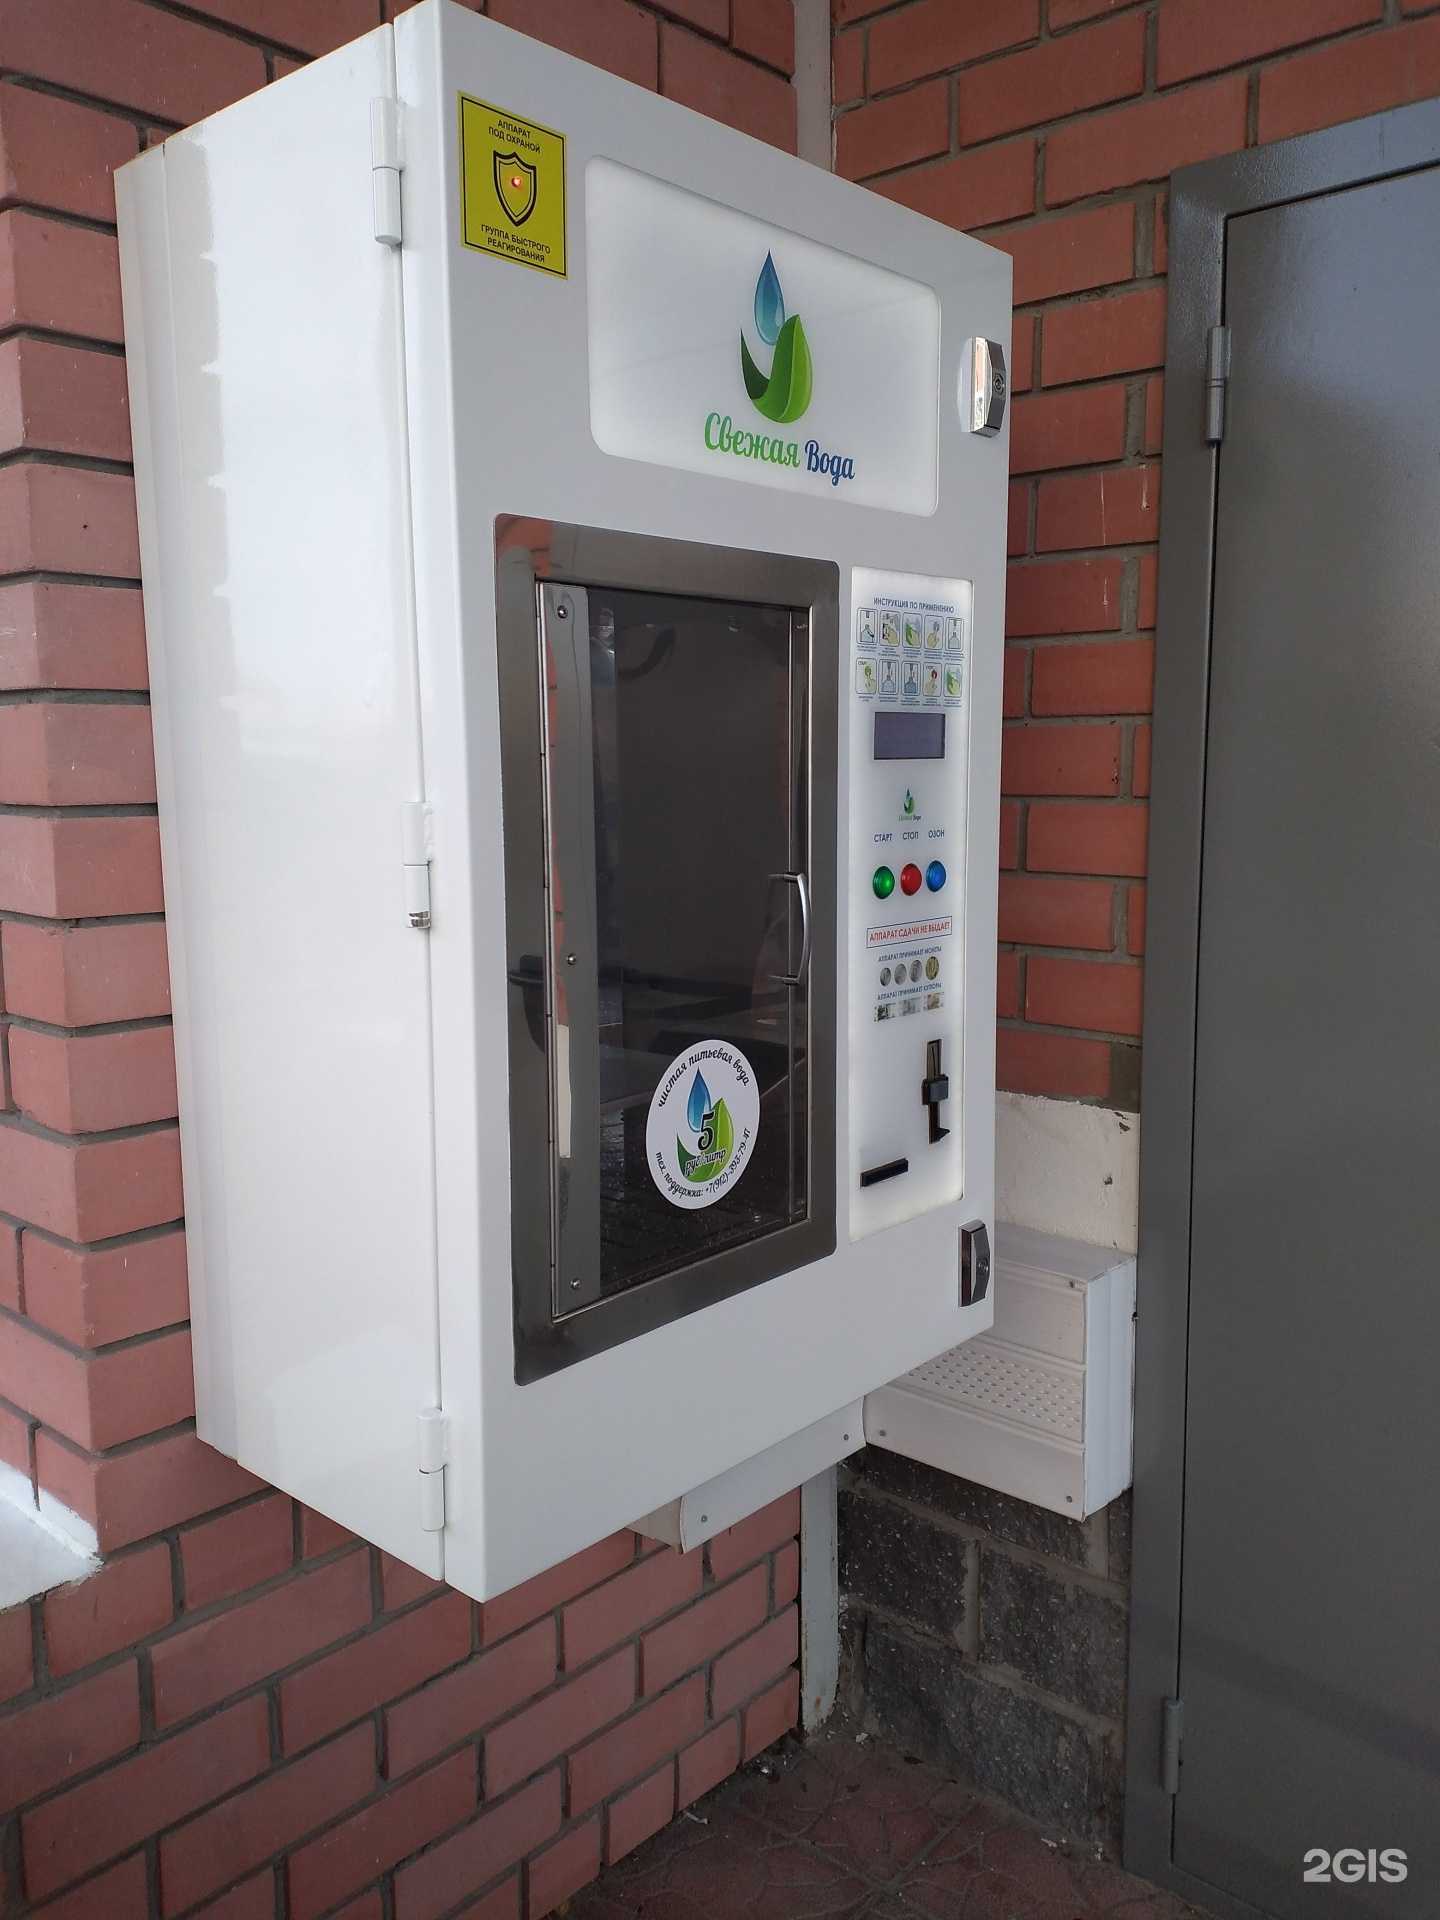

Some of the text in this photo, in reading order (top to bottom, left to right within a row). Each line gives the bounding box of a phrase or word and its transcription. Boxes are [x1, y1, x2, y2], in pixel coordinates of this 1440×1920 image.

[488, 126, 541, 153] ПОД ОХРАНОЙ
[498, 119, 531, 139] АППАРАТ
[481, 224, 551, 254] ГРУППА БЫСТРОГО
[487, 237, 546, 263] РЕАГИРОВАНИЯ
[704, 412, 855, 486] Свежая Вода
[873, 597, 955, 614] ИНСТРУКЦИЯ ПО ПРИМЕНЕНИЮ
[873, 832, 893, 843] СТАРТ
[902, 831, 919, 840] СТОП
[928, 829, 945, 839] ОЗОН
[870, 931, 898, 942] АППАРАТ
[898, 927, 920, 937] СДАЧИ
[920, 925, 928, 934] НЕ
[658, 1048, 750, 1108] чистая питьевая вода
[697, 1111, 715, 1151] 5
[655, 1151, 666, 1175] тех.
